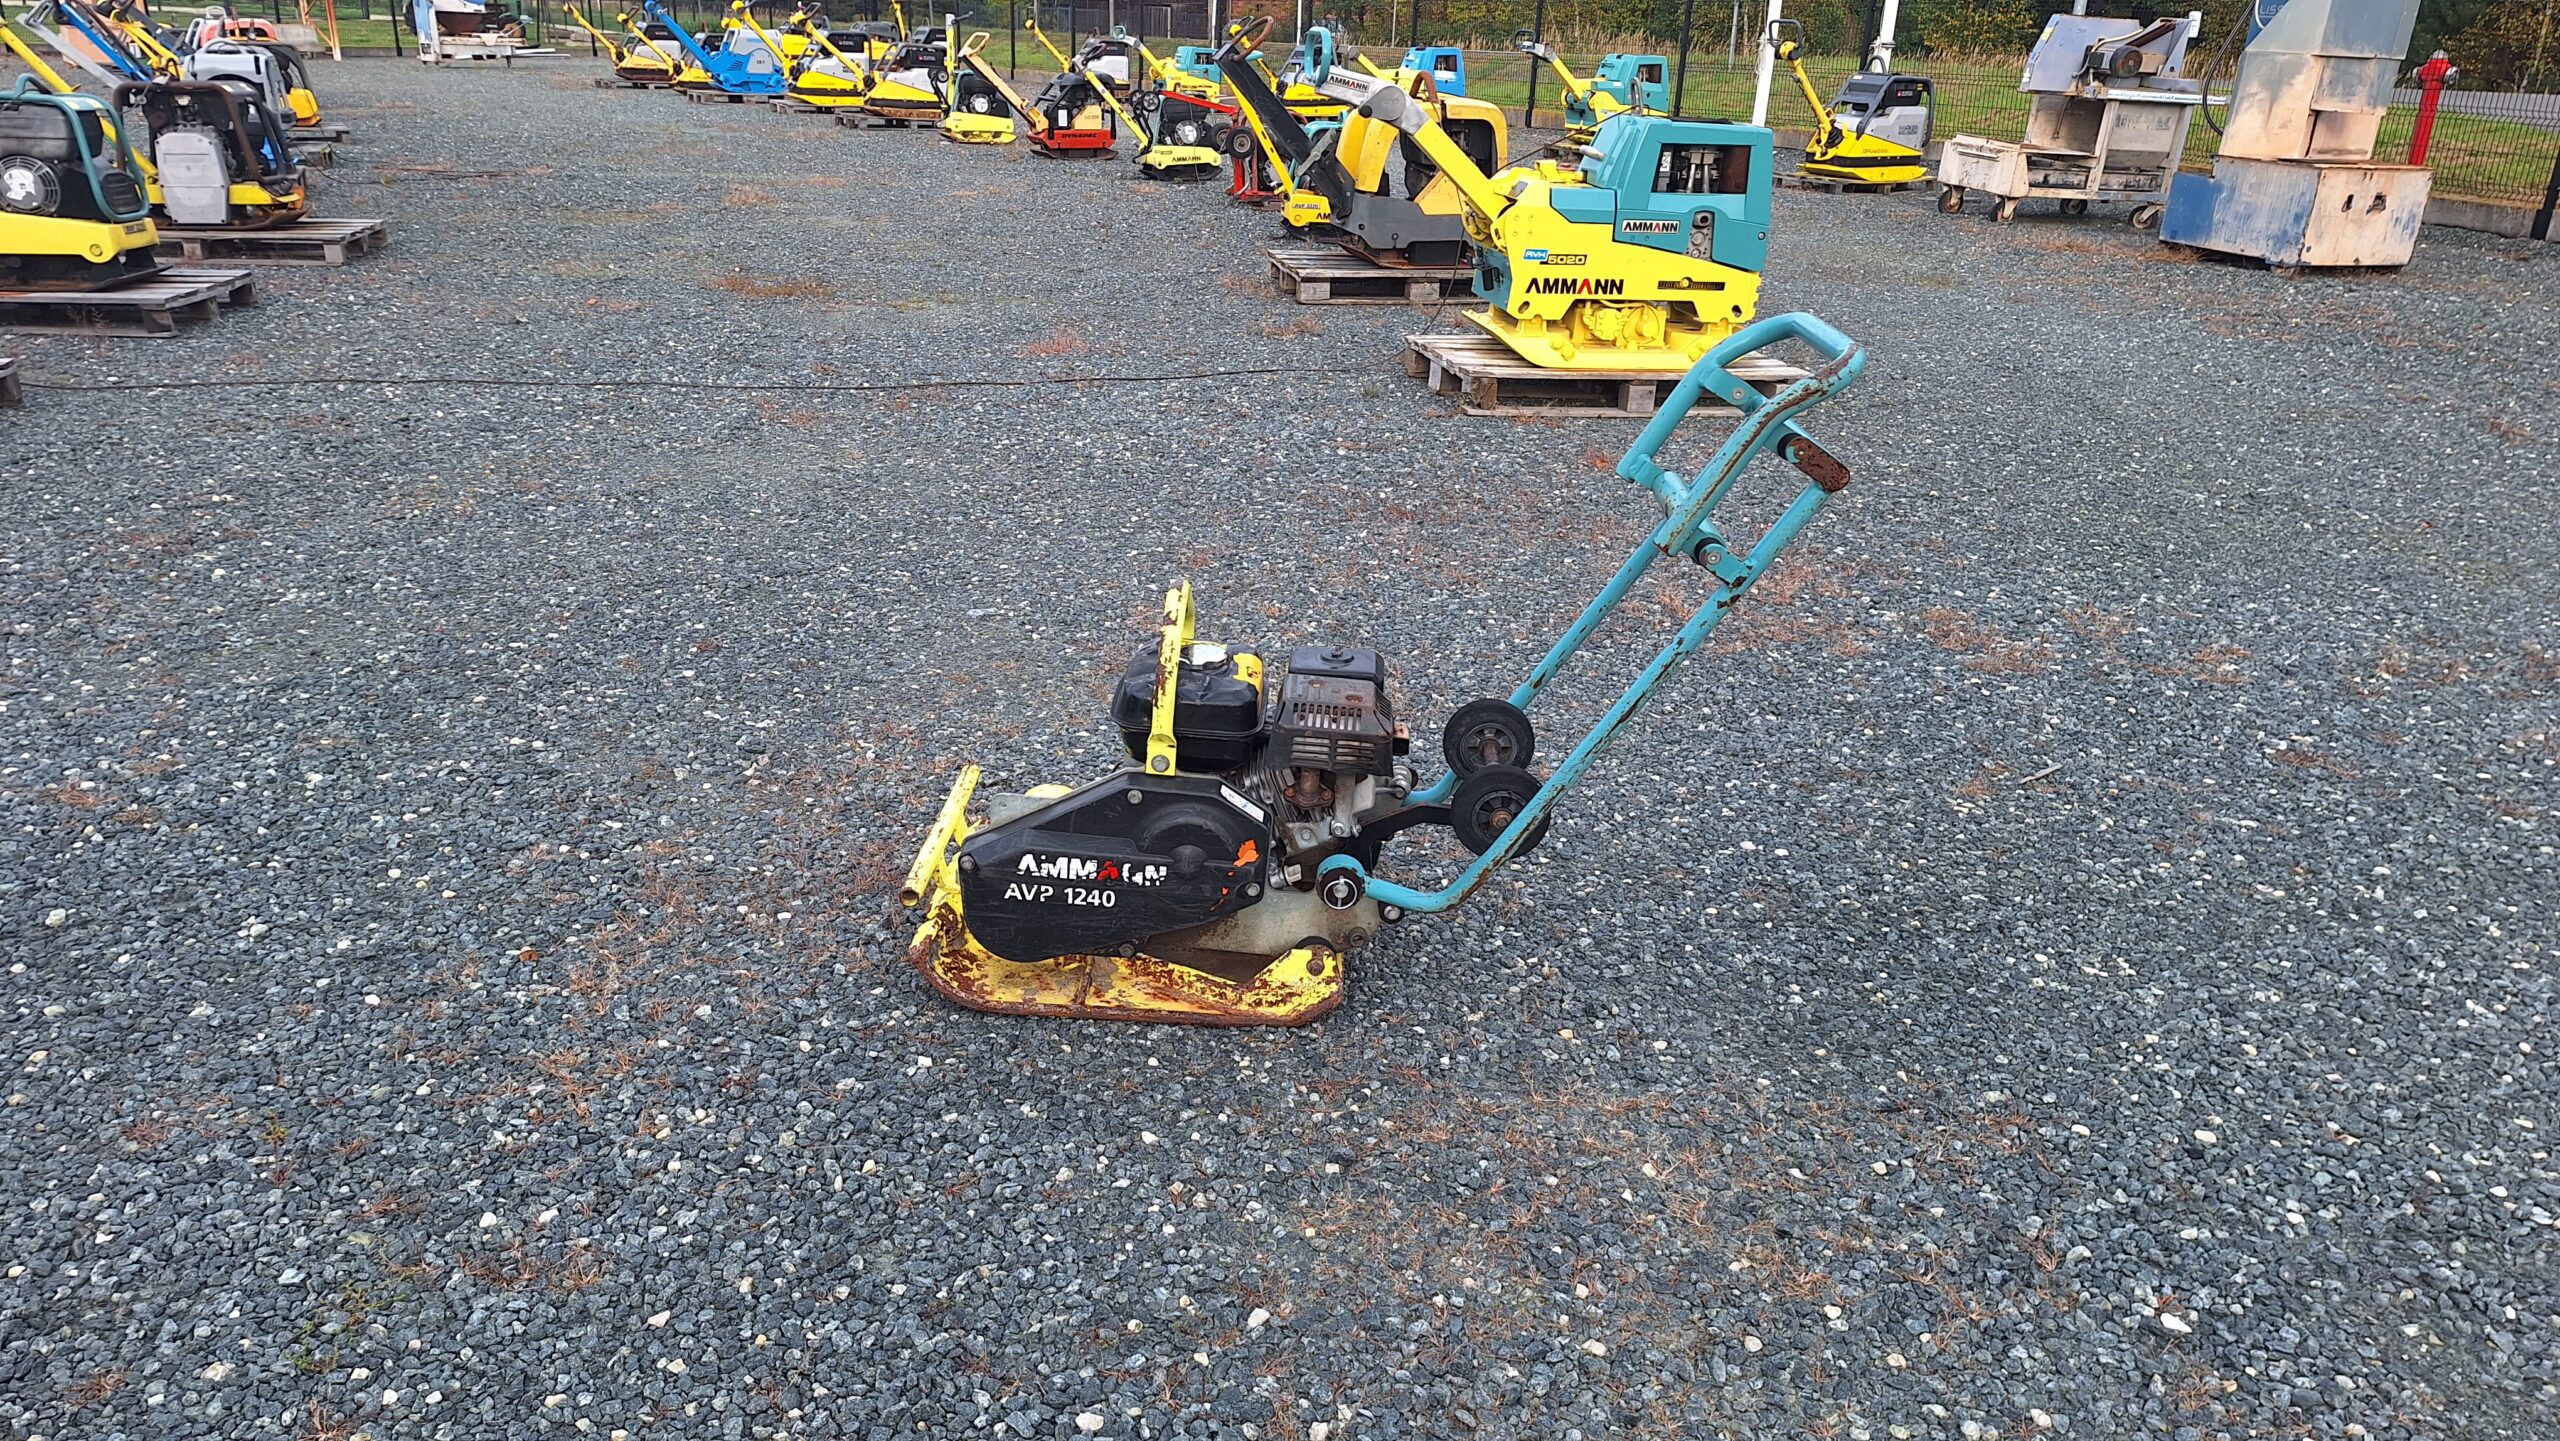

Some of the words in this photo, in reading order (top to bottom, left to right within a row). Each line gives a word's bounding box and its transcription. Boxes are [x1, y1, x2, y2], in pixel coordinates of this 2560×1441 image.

[1329, 75, 1368, 91] AMMANN
[1623, 221, 1679, 233] AMMANN
[1547, 255, 1586, 265] 5020
[1525, 277, 1625, 295] AMMANN
[1063, 887, 1116, 908] 1240
